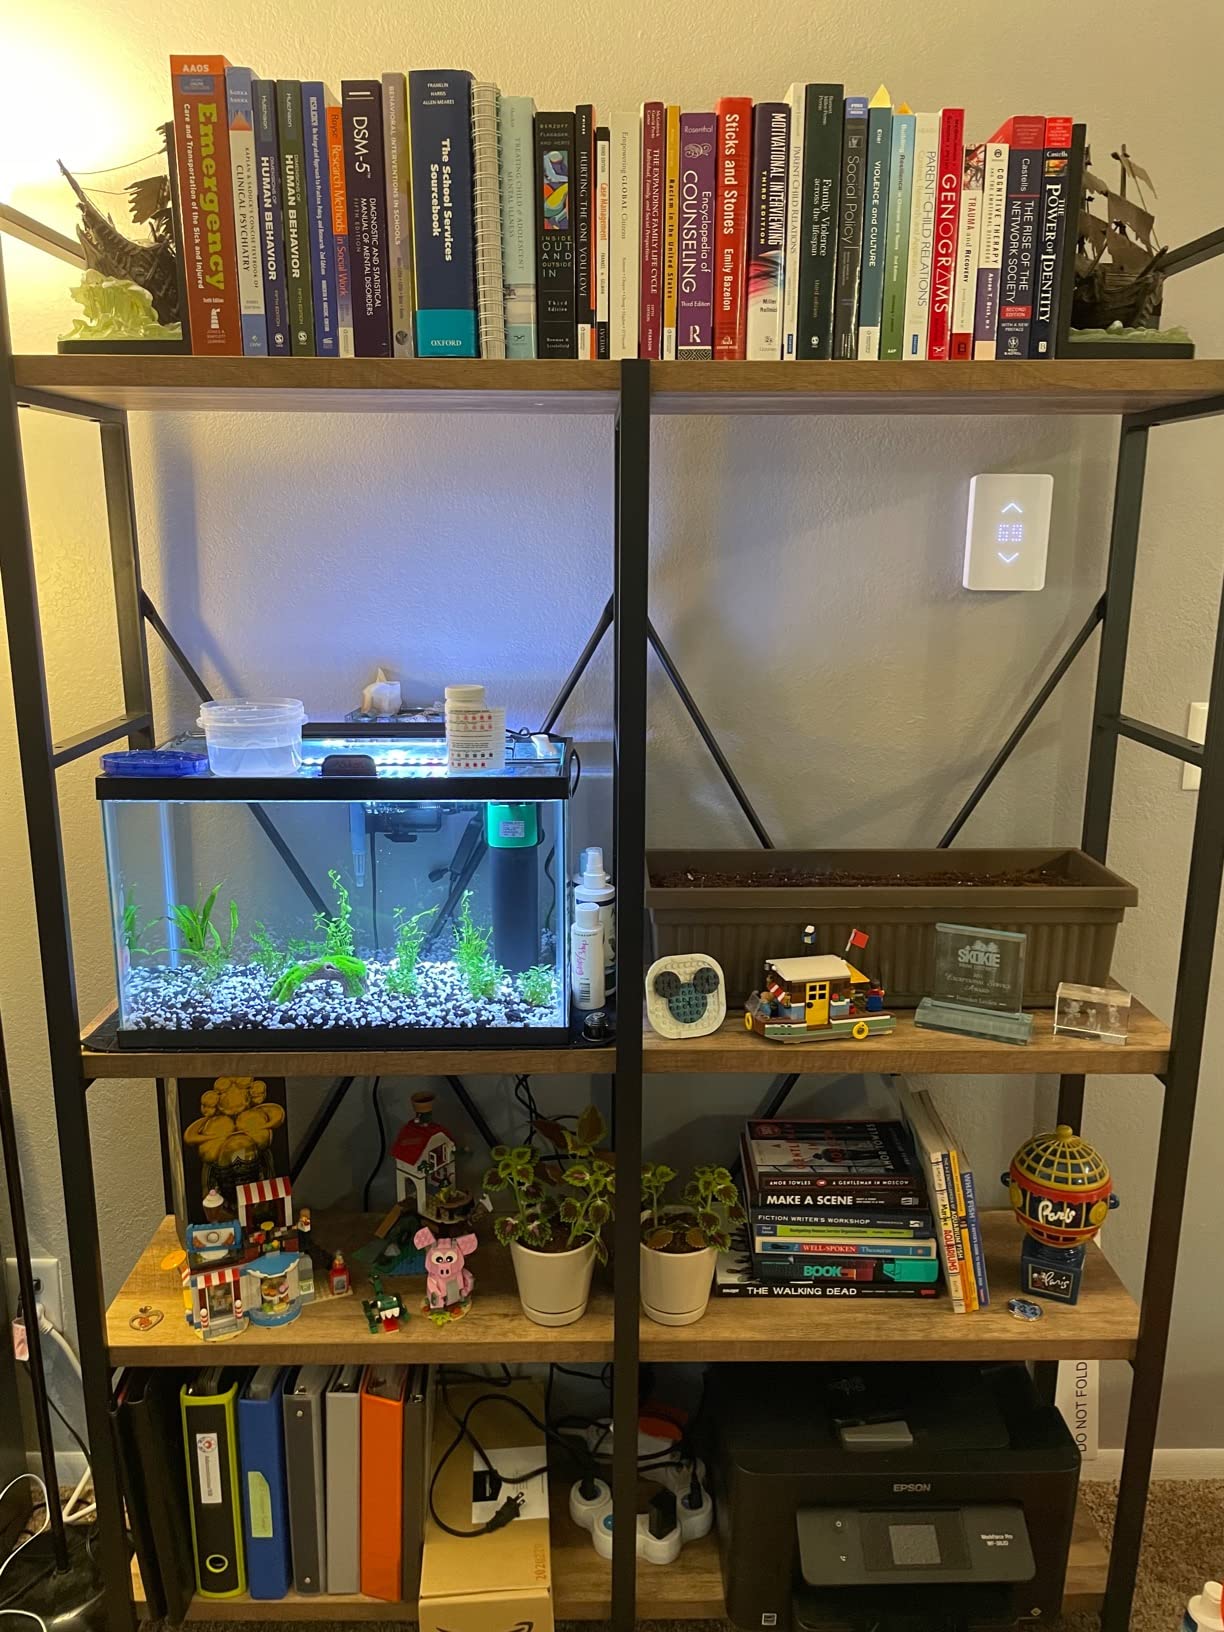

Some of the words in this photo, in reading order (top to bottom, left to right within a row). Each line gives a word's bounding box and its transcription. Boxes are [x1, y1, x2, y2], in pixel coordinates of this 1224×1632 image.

[183, 64, 209, 72] AAOS
[261, 95, 269, 130] Hutchison
[388, 86, 396, 136] BEHAVIORAL
[441, 138, 451, 162] The
[725, 114, 740, 156] Sticks
[770, 113, 786, 178] MOTIVATIONAL
[332, 144, 344, 188] Research
[390, 137, 399, 198] INTERVENTIONS
[620, 132, 629, 174] Empowering
[792, 146, 801, 178] PARENT
[186, 142, 196, 200] Transportation
[236, 165, 246, 210] CLINICAL
[261, 156, 272, 208] HUMAN
[286, 154, 296, 206] HUMAN
[442, 165, 452, 206] School
[580, 151, 588, 197] HURTING
[724, 160, 738, 185] and
[846, 155, 860, 199] Social
[872, 160, 881, 205] VIOLENCE
[1020, 158, 1030, 192] Castells
[191, 202, 198, 210] of
[198, 103, 224, 290] Emergency
[272, 196, 277, 204] OF
[296, 194, 301, 202] OF
[394, 200, 400, 208] IN
[430, 164, 442, 237] Sourcebook
[600, 182, 608, 198] Case
[652, 168, 660, 216] EXPANDING
[791, 180, 800, 207] CHILD
[820, 179, 832, 213] Family
[922, 151, 936, 238] PARENT-CHILD
[994, 168, 1004, 218] COGNITIVE
[1058, 198, 1066, 216] THE
[191, 212, 199, 224] the
[334, 190, 347, 232] Methods
[360, 198, 369, 231] MANUAL
[369, 198, 380, 246] DIAGNOSTIC
[392, 210, 401, 246] SCHOOLS
[598, 198, 608, 240] Management
[668, 212, 674, 220] in
[699, 192, 712, 259] Encyclopedia
[723, 190, 738, 235] Stones
[768, 182, 784, 246] INTERVIEWING
[841, 203, 858, 244] Policy
[966, 197, 976, 230] TRAUMA
[1008, 200, 1021, 256] NETWORK
[1024, 200, 1034, 222] THE
[1046, 184, 1062, 240] POWER
[193, 227, 202, 244] Sick
[239, 213, 250, 272] PSYCHIATRY
[264, 212, 276, 280] BEHAVIOR
[288, 210, 300, 278] BEHAVIOR
[336, 236, 345, 244] in
[362, 233, 370, 244] OF
[444, 210, 454, 262] Services
[542, 242, 572, 251] OUT
[580, 222, 588, 241] ONE
[682, 170, 698, 293] COUNSELING
[790, 209, 800, 254] RELATIONS
[810, 224, 820, 256] lifespan
[819, 216, 830, 256] Violence
[868, 226, 878, 267] CULTURE
[934, 174, 957, 313] GENOGRAMS
[992, 224, 1001, 264] THERAPY
[1021, 225, 1032, 249] RISE
[1046, 242, 1054, 252] OF
[337, 246, 348, 272] Social
[363, 246, 371, 275] MENTAL
[372, 248, 380, 265] AND
[542, 252, 572, 260] AND
[579, 247, 587, 270] YOU
[700, 262, 711, 272] of
[722, 248, 734, 273] Emily
[962, 250, 972, 282] RECOVERY
[1020, 252, 1031, 268] OF
[195, 262, 204, 289] Injured
[338, 272, 350, 296] Work
[373, 266, 382, 308] STATISTICAL
[544, 269, 556, 278] IN
[918, 242, 930, 306] RELATIONS
[1006, 258, 1018, 304] SOCIETY
[1018, 270, 1030, 290] THE
[1039, 254, 1056, 322] IDENTITY
[364, 276, 374, 316] DISORDERS
[723, 276, 733, 311] Bazelon
[998, 524, 1022, 542] 69
[958, 948, 1000, 968] SKOKIE
[766, 1196, 800, 1205] MAKE
[804, 1196, 813, 1204] A
[816, 1196, 854, 1205] SCENE
[964, 1174, 974, 1199] WHAT
[827, 1217, 870, 1225] WORKSHOP
[1038, 1200, 1076, 1224] Paris
[802, 1244, 856, 1252] WELL-SPOKEN
[944, 1230, 958, 1272] AQUARIUMS
[950, 1210, 962, 1243] AQUARIUM
[956, 1244, 964, 1258] FISH
[803, 1266, 842, 1278] BOOK
[1044, 1272, 1070, 1288] Paris
[746, 1287, 768, 1295] THE
[773, 1287, 824, 1295] WALKING
[826, 1288, 857, 1296] DEAD
[1076, 1362, 1088, 1398] FOLD
[1076, 1402, 1087, 1429] NOT
[1076, 1432, 1087, 1452] DO
[893, 1484, 931, 1492] EPSON
